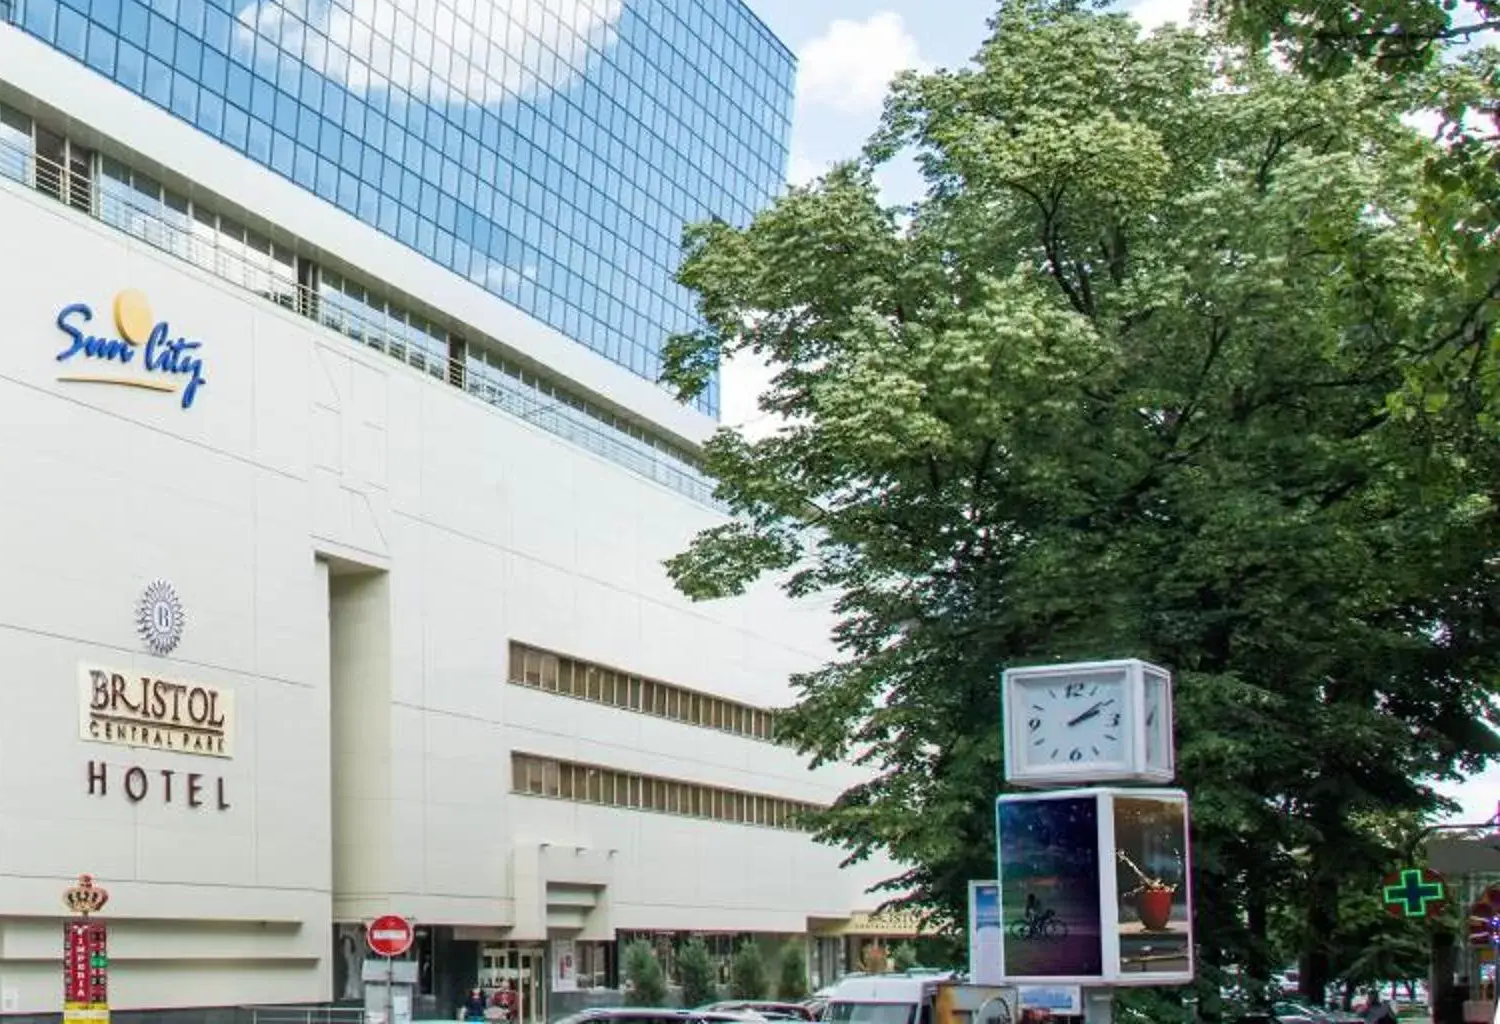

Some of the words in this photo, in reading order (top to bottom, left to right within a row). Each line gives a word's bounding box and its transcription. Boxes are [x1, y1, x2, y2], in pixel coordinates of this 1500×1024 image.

[55, 304, 135, 363] Sun
[145, 322, 206, 409] City
[89, 669, 225, 728] BRISTOL
[1065, 682, 1085, 699] 12
[88, 720, 173, 749] CENTRAL
[183, 733, 225, 754] PARK
[1028, 718, 1041, 731] 9
[1109, 713, 1121, 727] 3
[1069, 747, 1083, 761] 6
[87, 760, 231, 812] HOTEL
